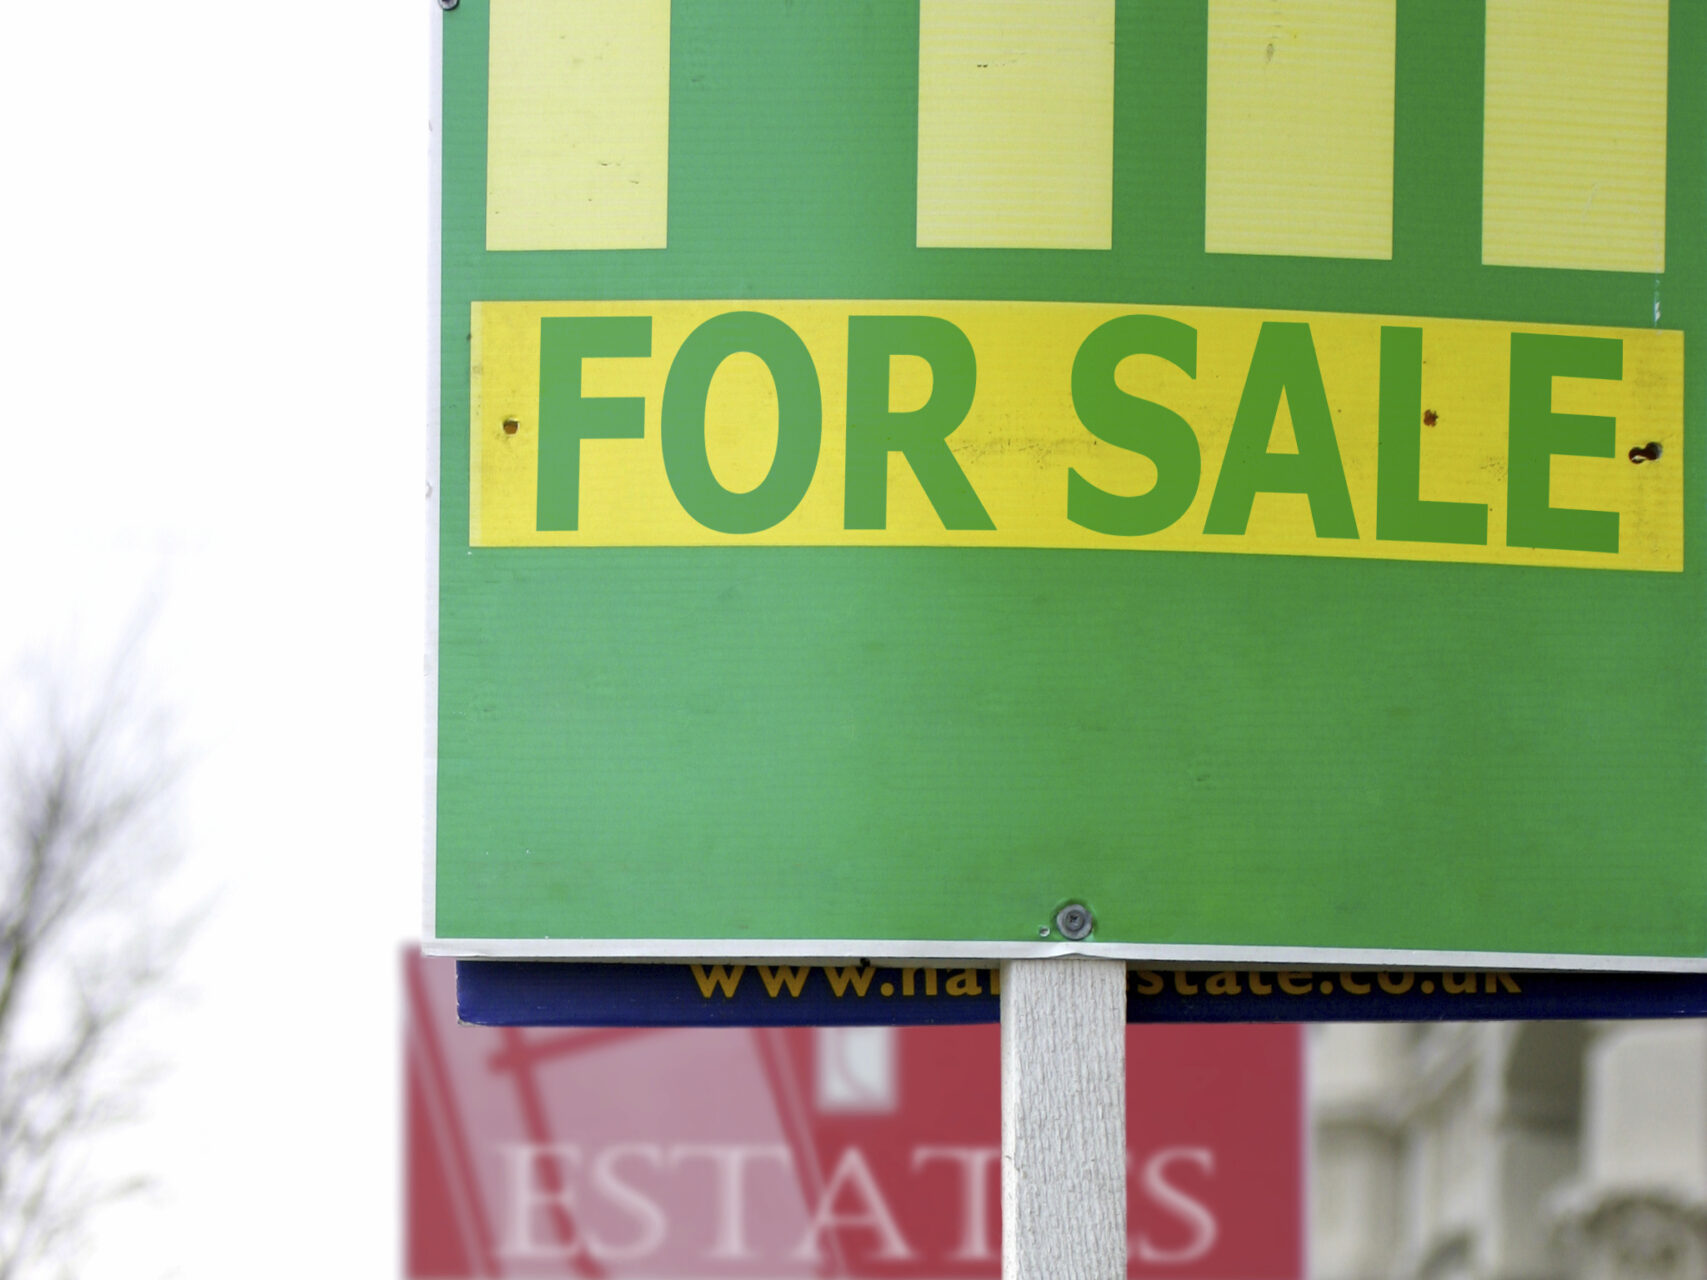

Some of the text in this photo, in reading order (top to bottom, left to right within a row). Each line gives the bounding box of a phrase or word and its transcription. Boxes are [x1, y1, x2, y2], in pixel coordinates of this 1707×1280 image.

[536, 311, 1624, 555] FOR SALE
[495, 1143, 1220, 1265] ESTATS
